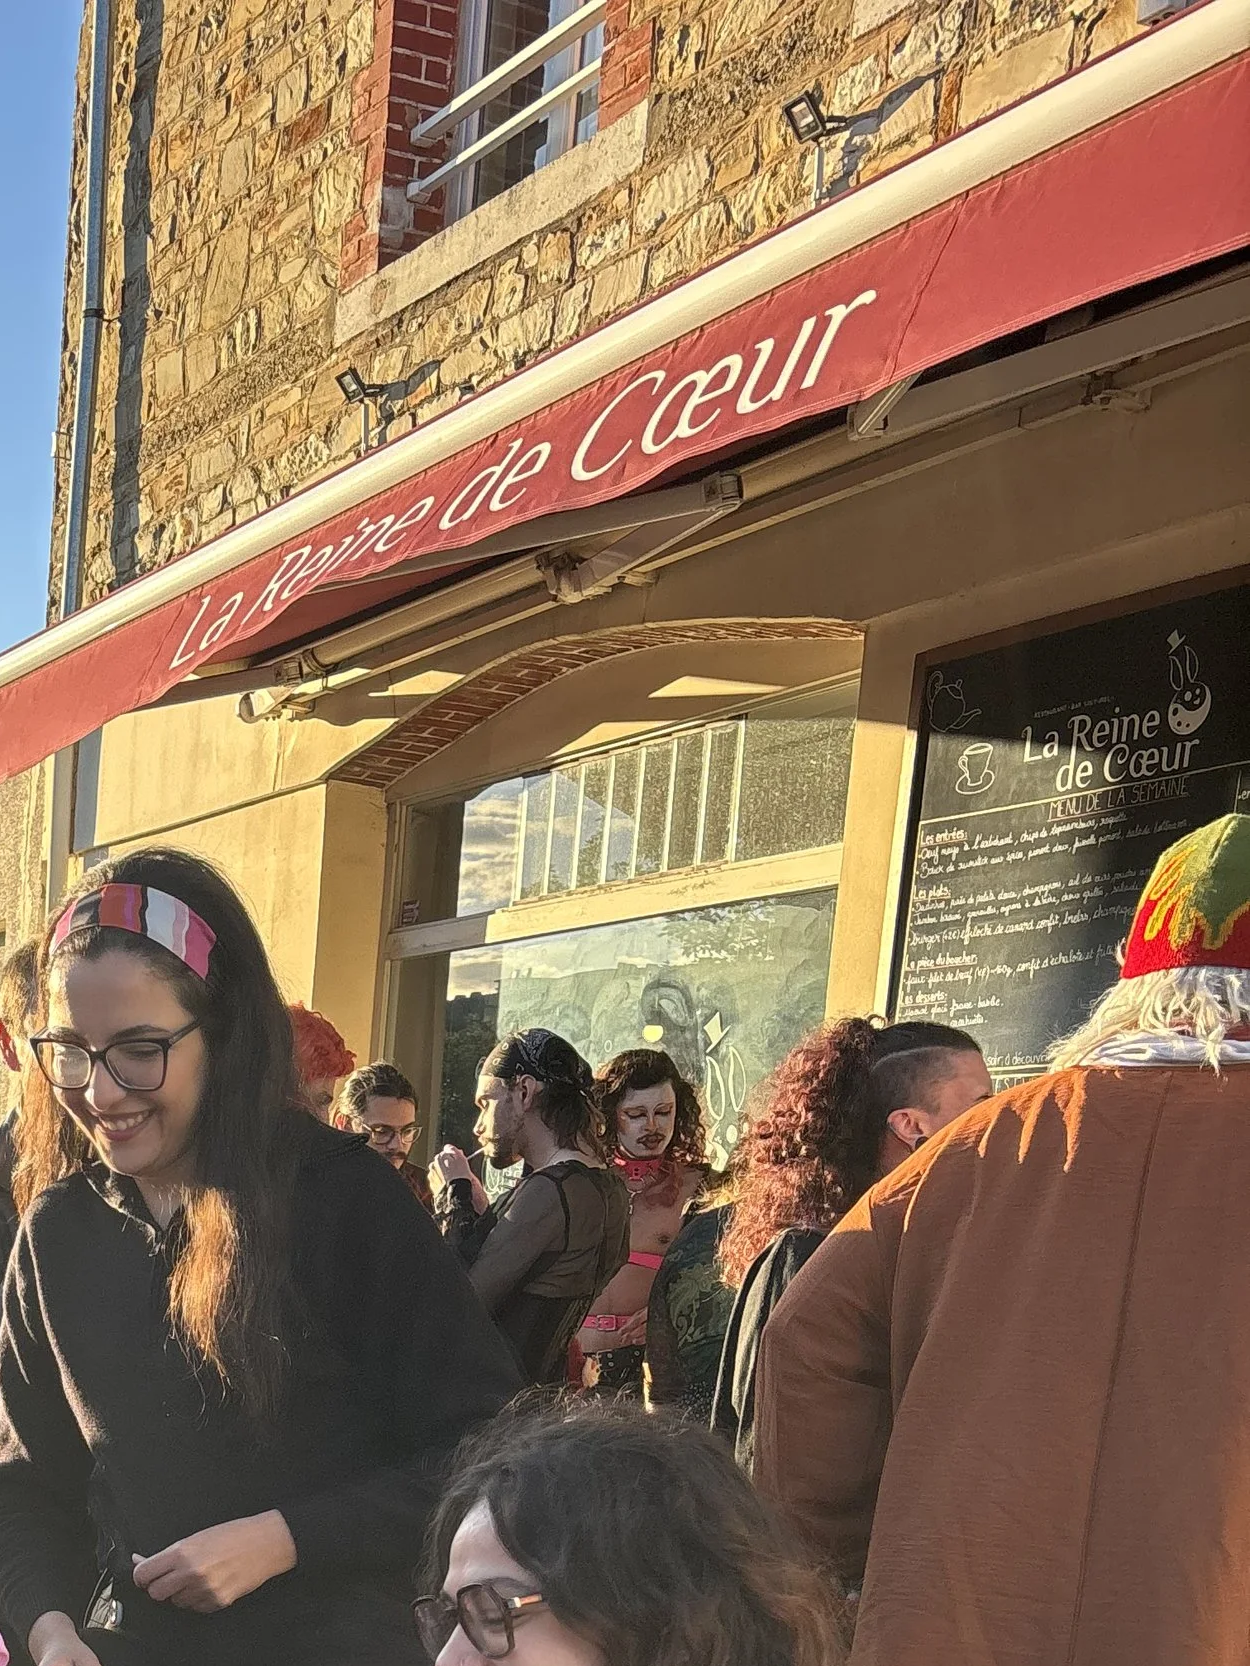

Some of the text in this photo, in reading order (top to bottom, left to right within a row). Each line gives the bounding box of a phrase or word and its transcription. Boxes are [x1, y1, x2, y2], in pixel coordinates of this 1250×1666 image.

[168, 288, 877, 671] La Reine de Cœur
[1021, 706, 1161, 763] La Reine
[1055, 738, 1200, 793] de Cœur
[1048, 776, 1189, 819] MENU DE LA SEMAINE
[920, 830, 935, 845] Les
[913, 885, 927, 900] Les
